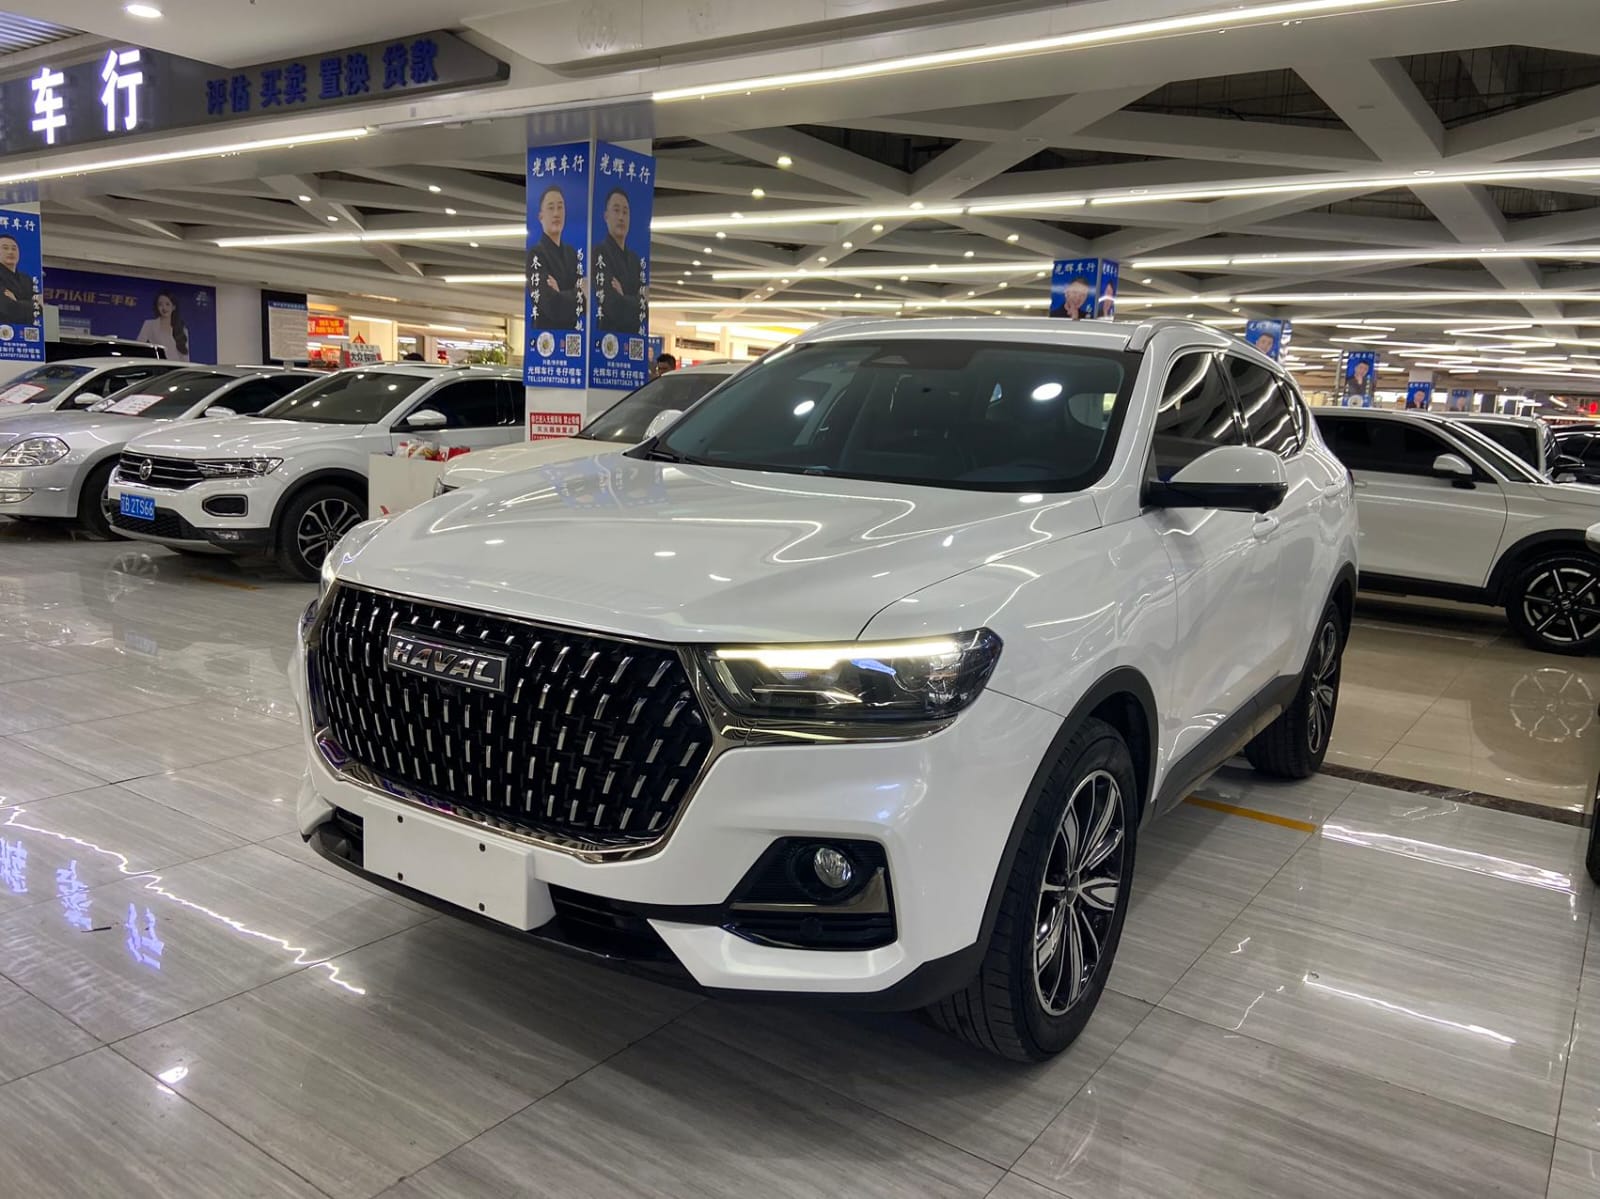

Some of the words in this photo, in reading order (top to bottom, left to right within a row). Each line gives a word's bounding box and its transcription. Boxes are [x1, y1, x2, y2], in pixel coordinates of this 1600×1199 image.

[31, 49, 143, 144] 车行
[206, 75, 251, 116] 评估
[260, 64, 308, 108] 买卖
[319, 54, 371, 99] 置换
[382, 38, 439, 90] 贷款
[391, 641, 497, 684] HAVAL
